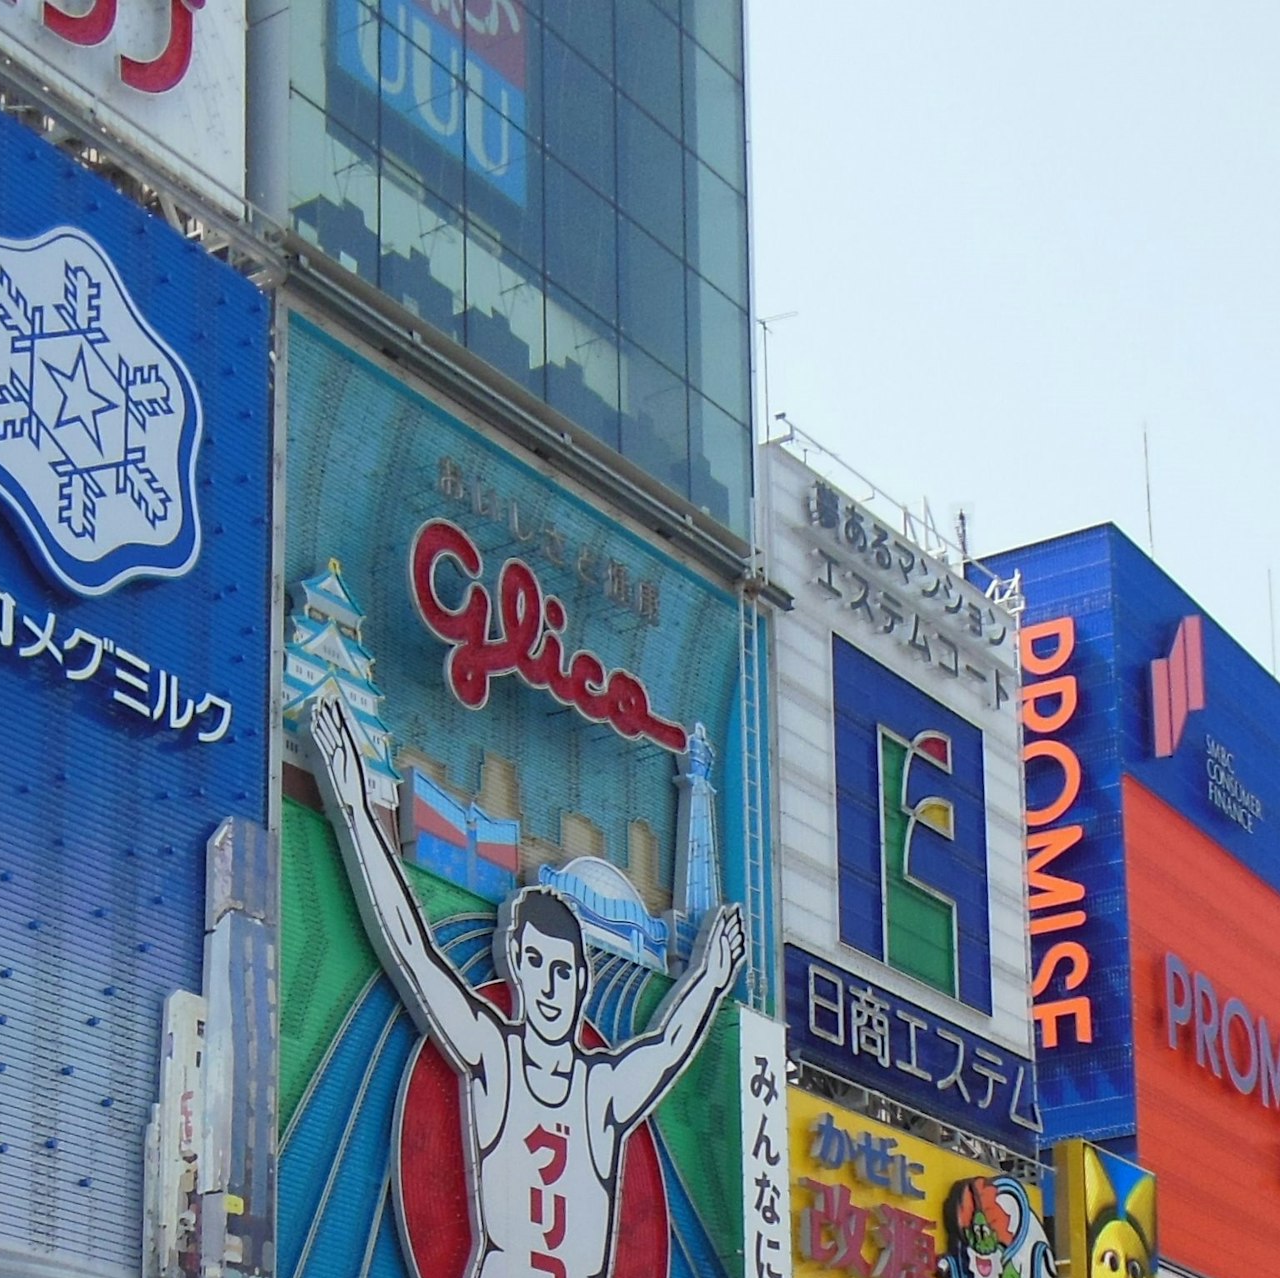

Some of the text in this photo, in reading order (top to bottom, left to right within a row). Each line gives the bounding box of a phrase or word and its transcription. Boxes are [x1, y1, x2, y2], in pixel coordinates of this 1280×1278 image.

[409, 517, 690, 754] Glico
[815, 548, 1010, 711] エステムコート
[809, 963, 1044, 1134] 日商エステム
[810, 1110, 927, 1201] かぜに
